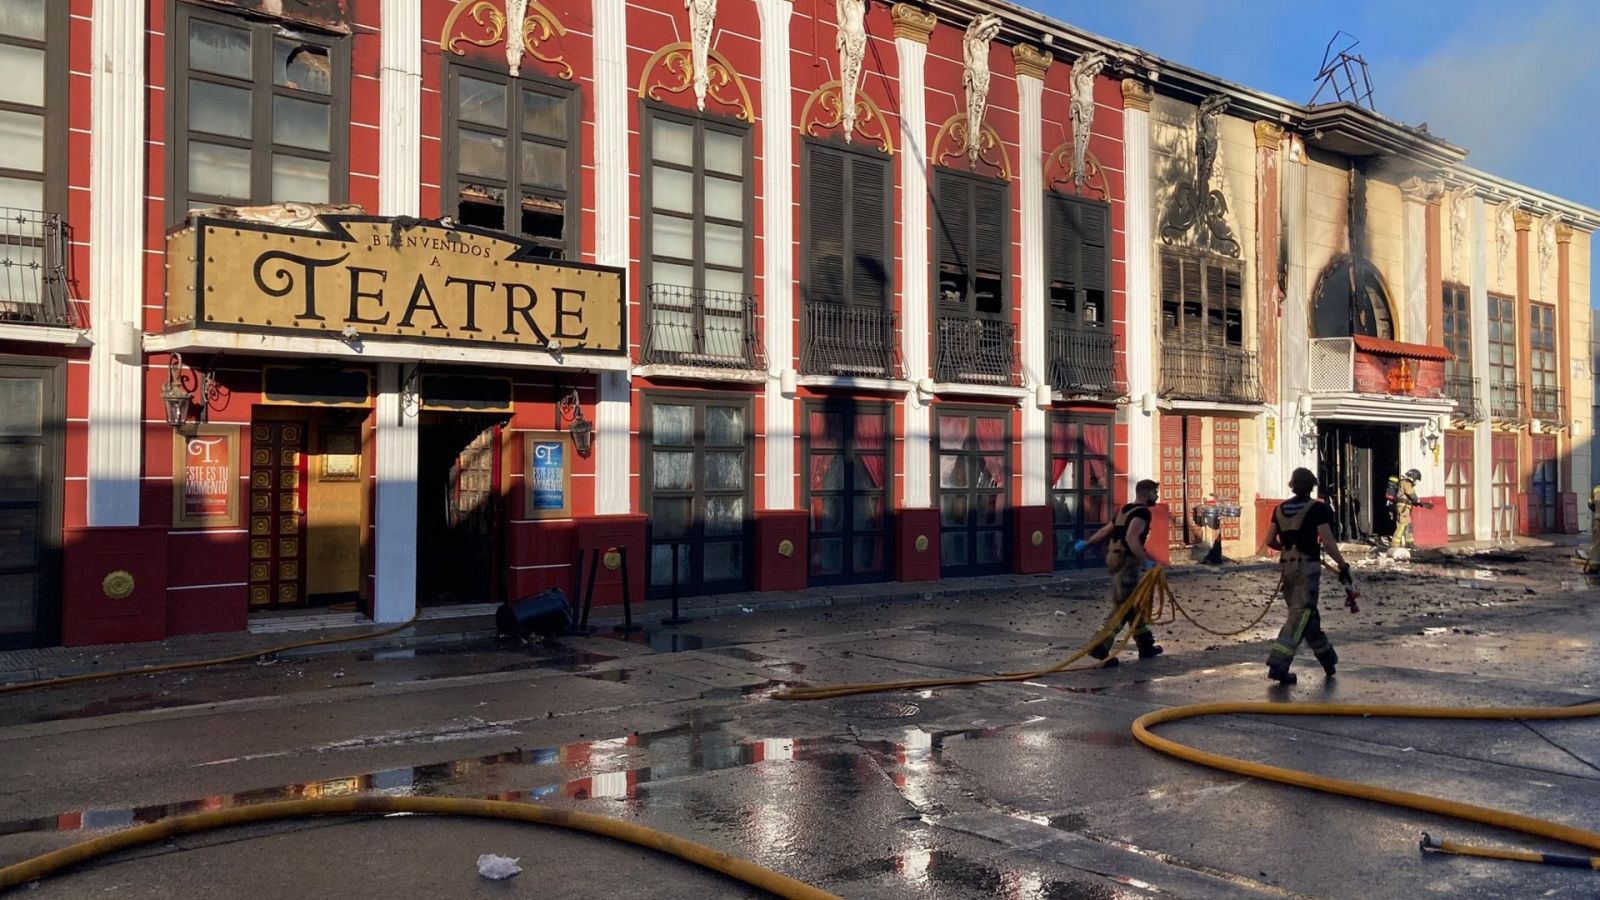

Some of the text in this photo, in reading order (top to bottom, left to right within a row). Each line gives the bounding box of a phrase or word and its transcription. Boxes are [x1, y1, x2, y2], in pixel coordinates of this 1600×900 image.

[430, 256, 440, 267] A
[253, 250, 588, 347] TEATRE
[186, 466, 228, 480] ESTE ES TU
[186, 480, 227, 495] MOMENTO
